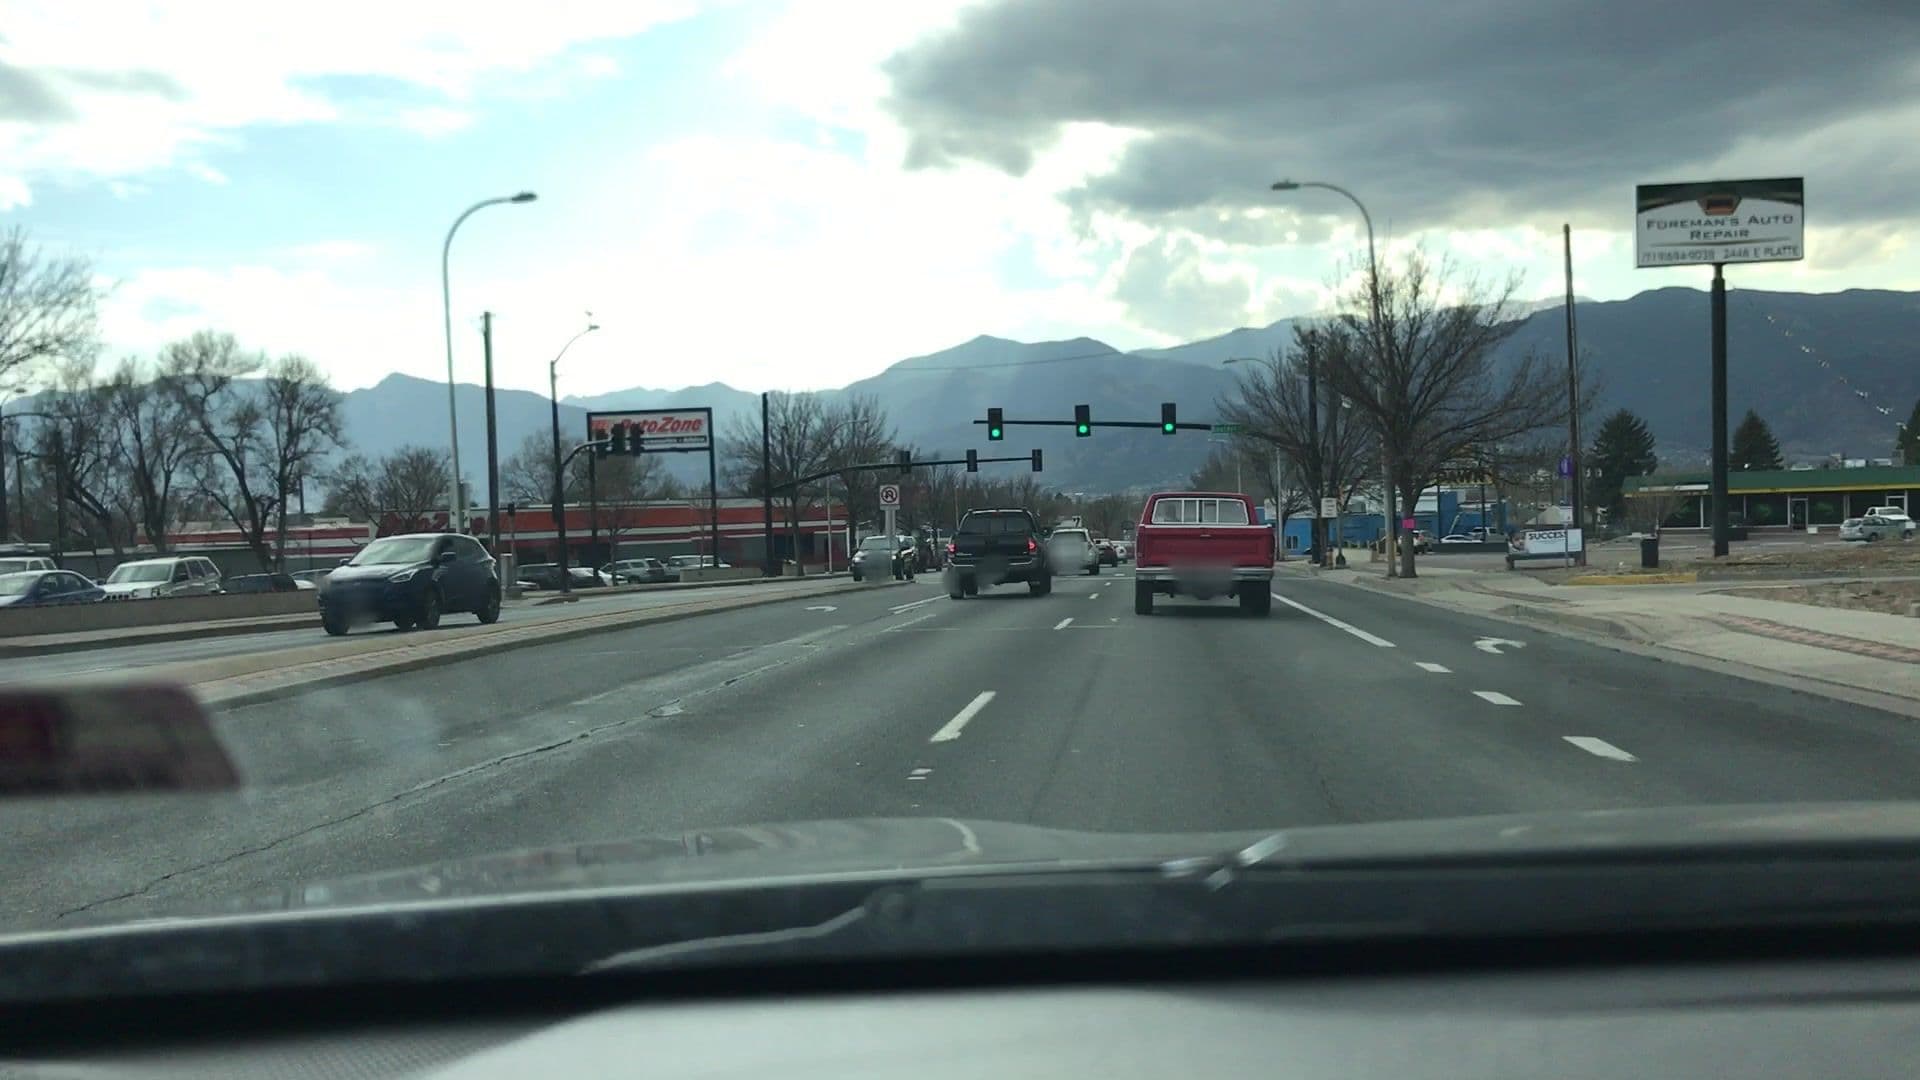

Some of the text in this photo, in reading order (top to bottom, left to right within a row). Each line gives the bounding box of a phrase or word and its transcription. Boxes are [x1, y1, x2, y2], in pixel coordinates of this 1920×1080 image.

[1646, 214, 1794, 231] FOREMAN'S AUTO
[1690, 230, 1750, 241] REPAIR
[1764, 245, 1799, 257] PLATTE
